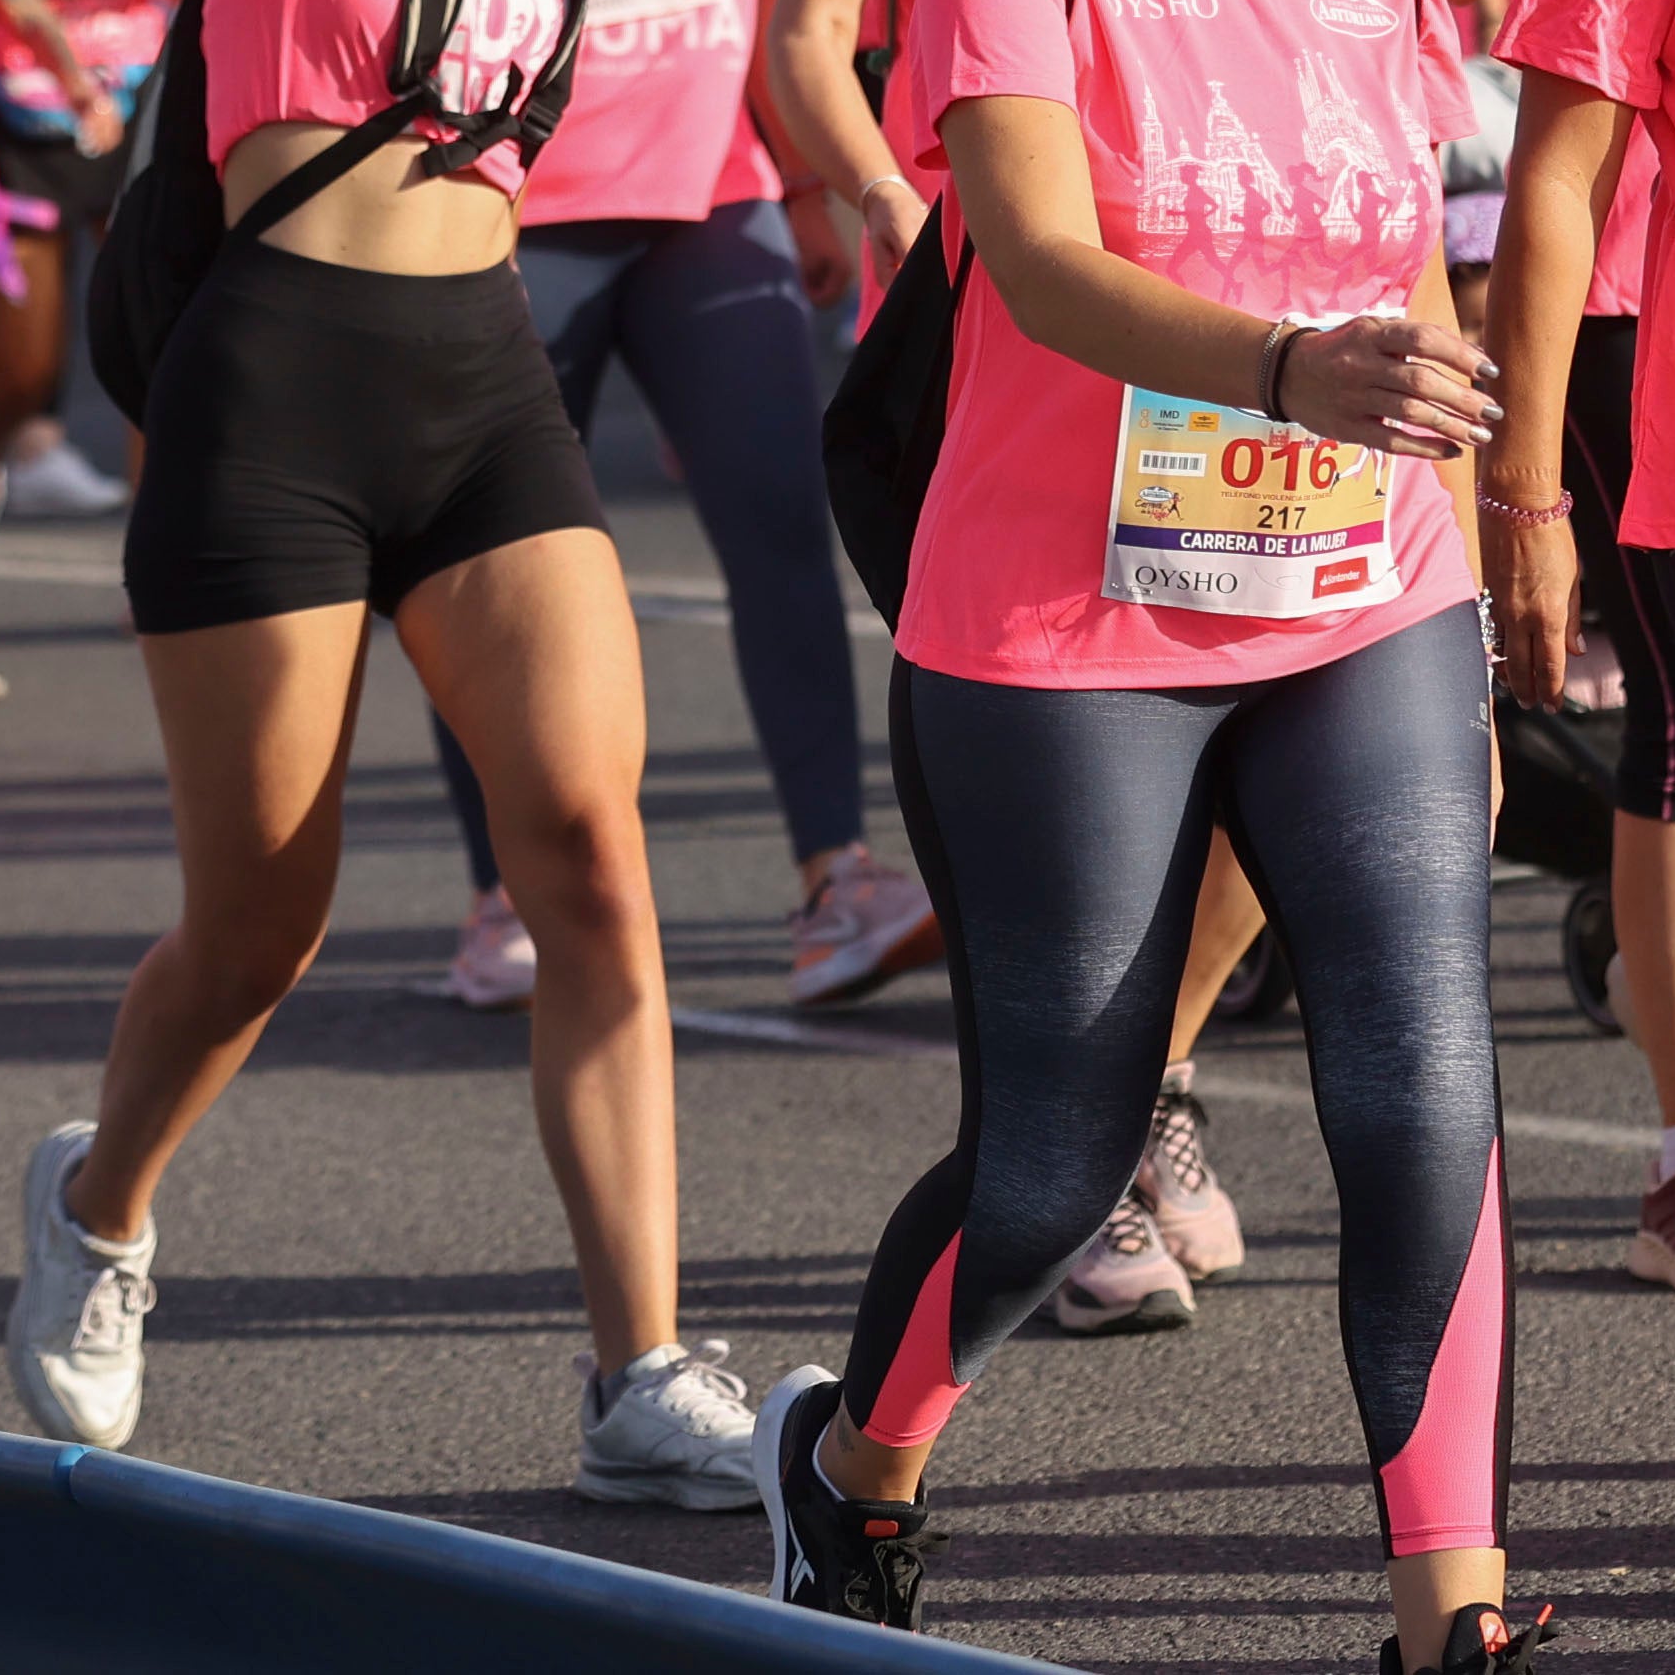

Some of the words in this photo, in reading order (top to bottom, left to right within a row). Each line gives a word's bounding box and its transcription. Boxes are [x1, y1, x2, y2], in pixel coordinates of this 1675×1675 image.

[1318, 0, 1393, 27] ASTURIANA
[1160, 410, 1180, 419] IMD
[1221, 437, 1339, 491] 016
[1257, 505, 1307, 530] 217
[1180, 532, 1259, 553] CARRERA
[1264, 537, 1287, 555] DE
[1291, 537, 1307, 555] LA
[1310, 531, 1348, 552] MUJER
[1135, 565, 1238, 594] OYSHO
